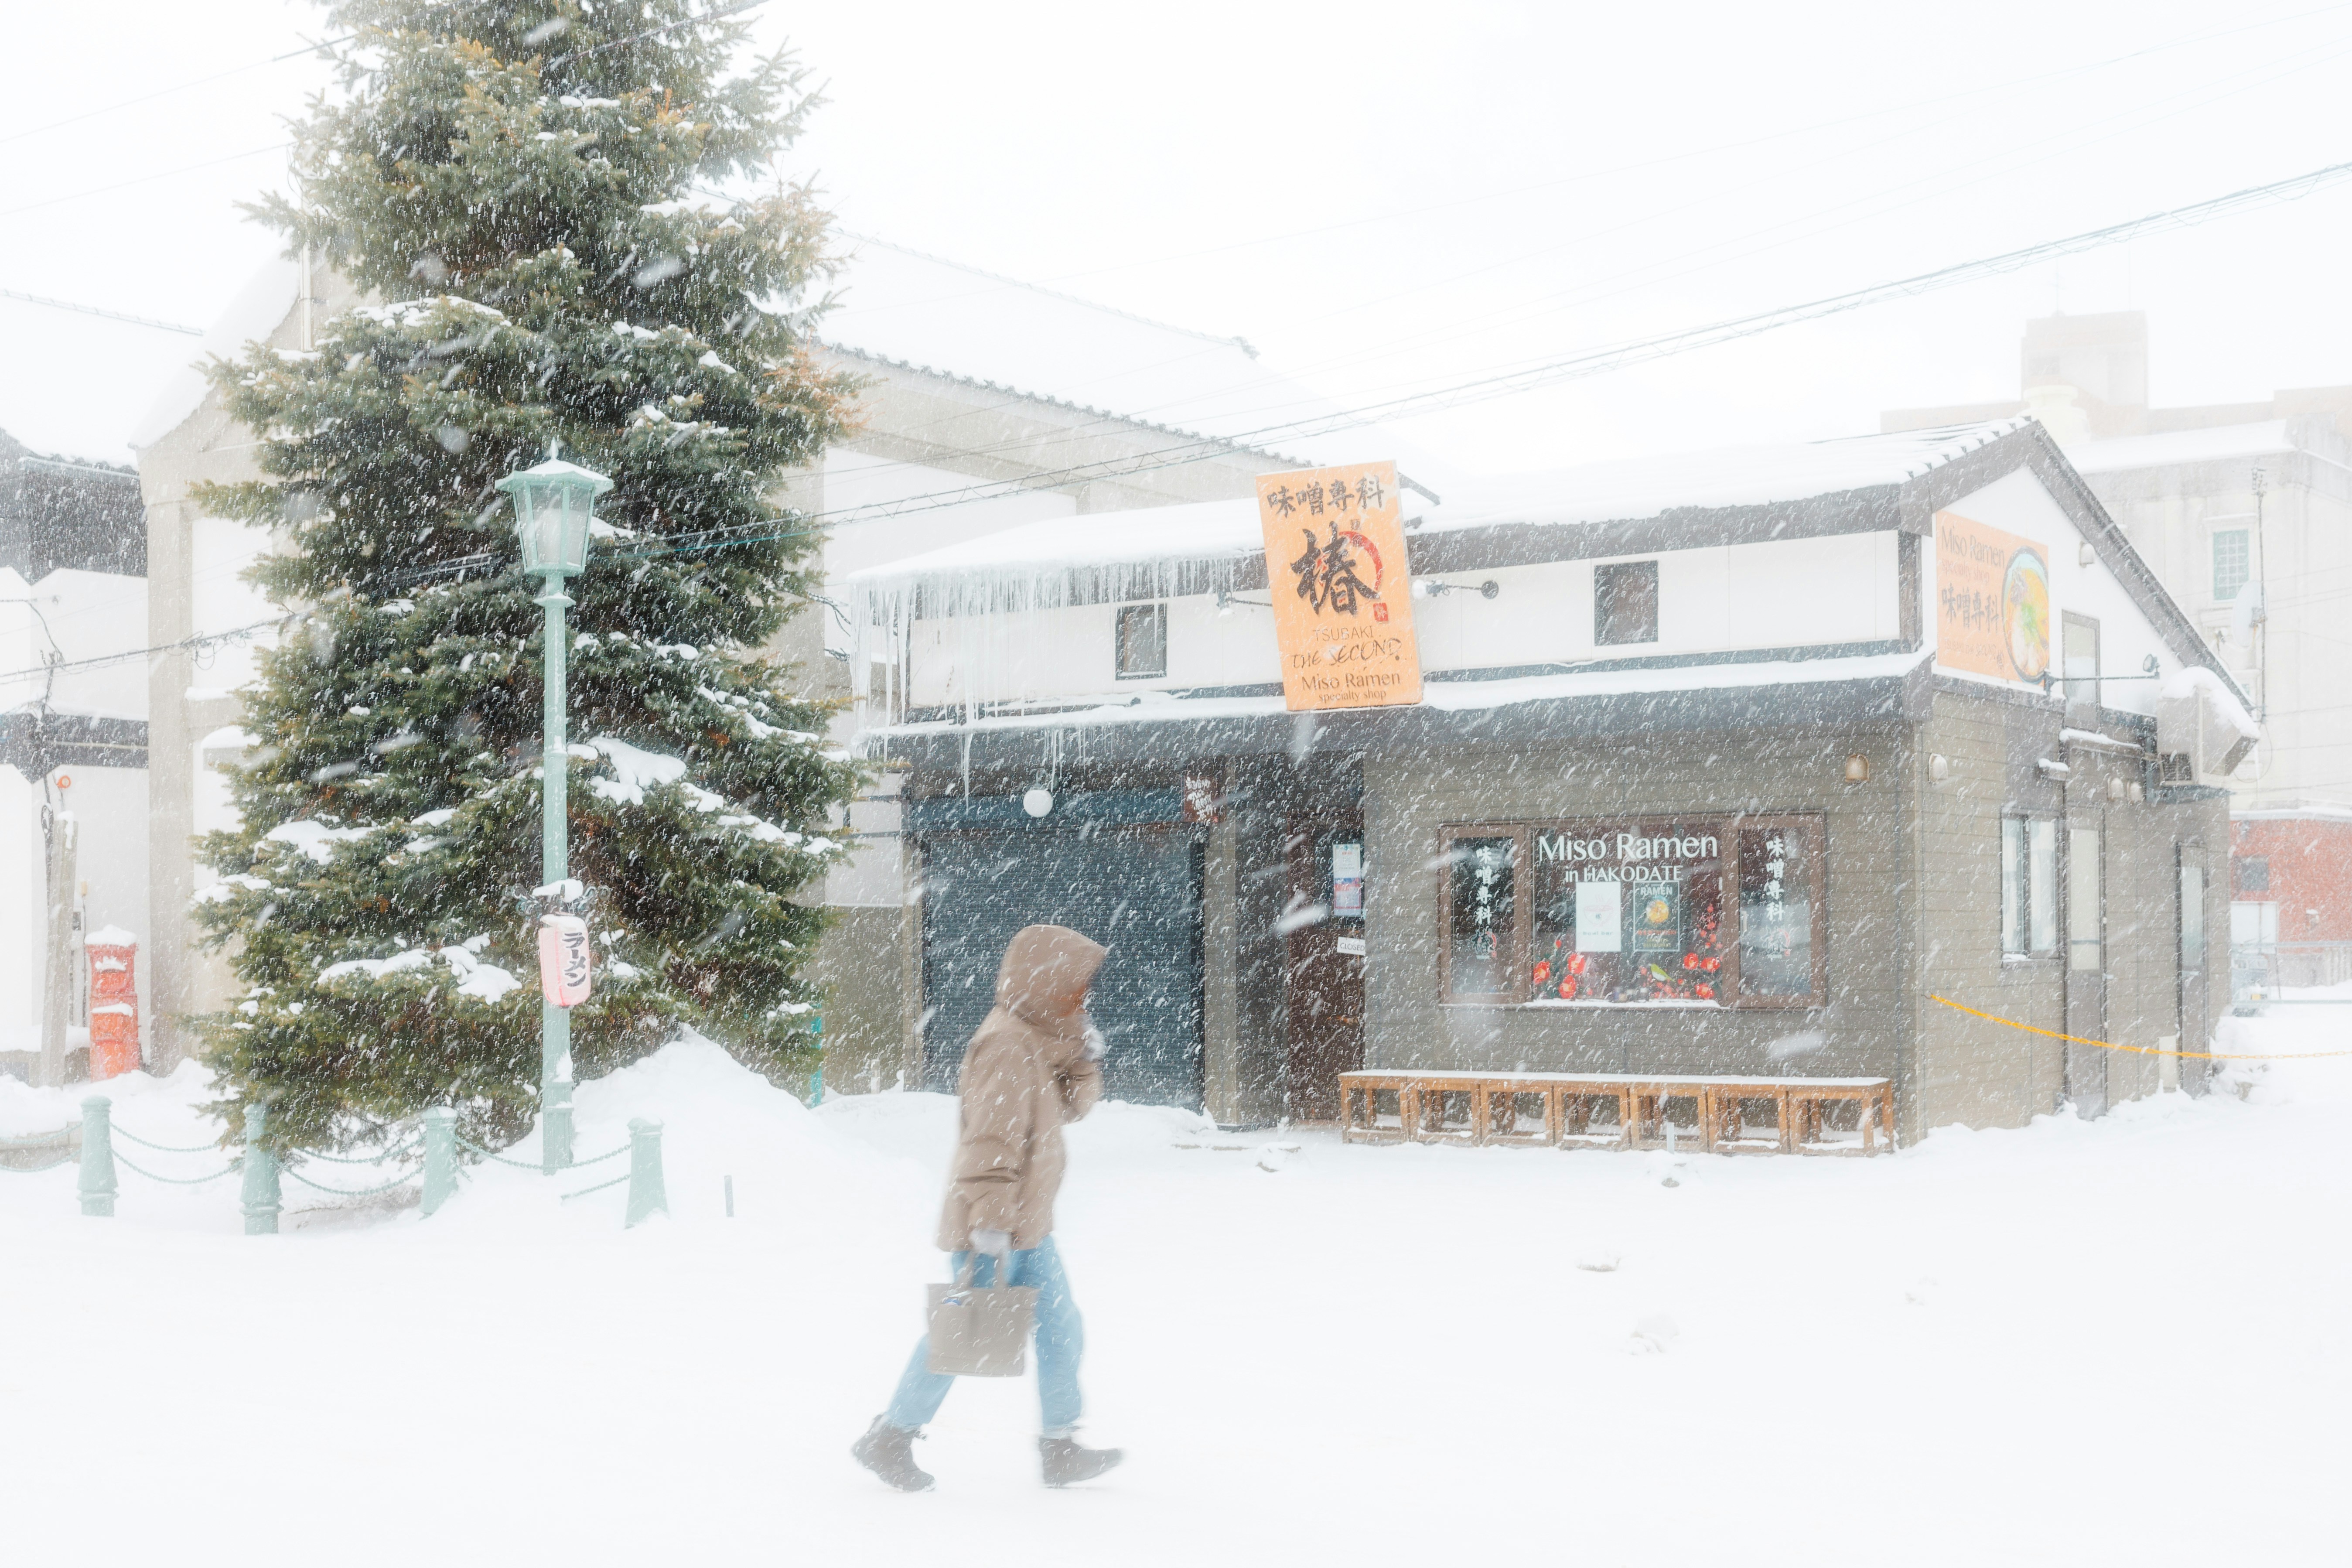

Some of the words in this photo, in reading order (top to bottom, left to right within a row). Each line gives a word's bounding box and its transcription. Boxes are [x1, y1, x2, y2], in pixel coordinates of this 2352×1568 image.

[1942, 526, 1967, 557] Miso
[1970, 534, 2005, 568] Ramen
[1290, 521, 1382, 615] 椿
[1942, 558, 1970, 583] specialty
[1973, 564, 1990, 586] shop
[1313, 625, 1374, 642] TSUBAKI
[1301, 673, 1340, 691] Miso
[1345, 673, 1401, 688] Ramen
[1318, 690, 1359, 703] specialty
[1363, 688, 1386, 700] shop
[1539, 831, 1607, 861] Miso
[1617, 833, 1718, 860] Ramen
[1565, 865, 1578, 882] in
[1584, 865, 1684, 882] HAKODATE
[1640, 886, 1673, 895] RAMEN
[1340, 942, 1365, 952] CLOSED
[562, 932, 586, 987] ラーメン
